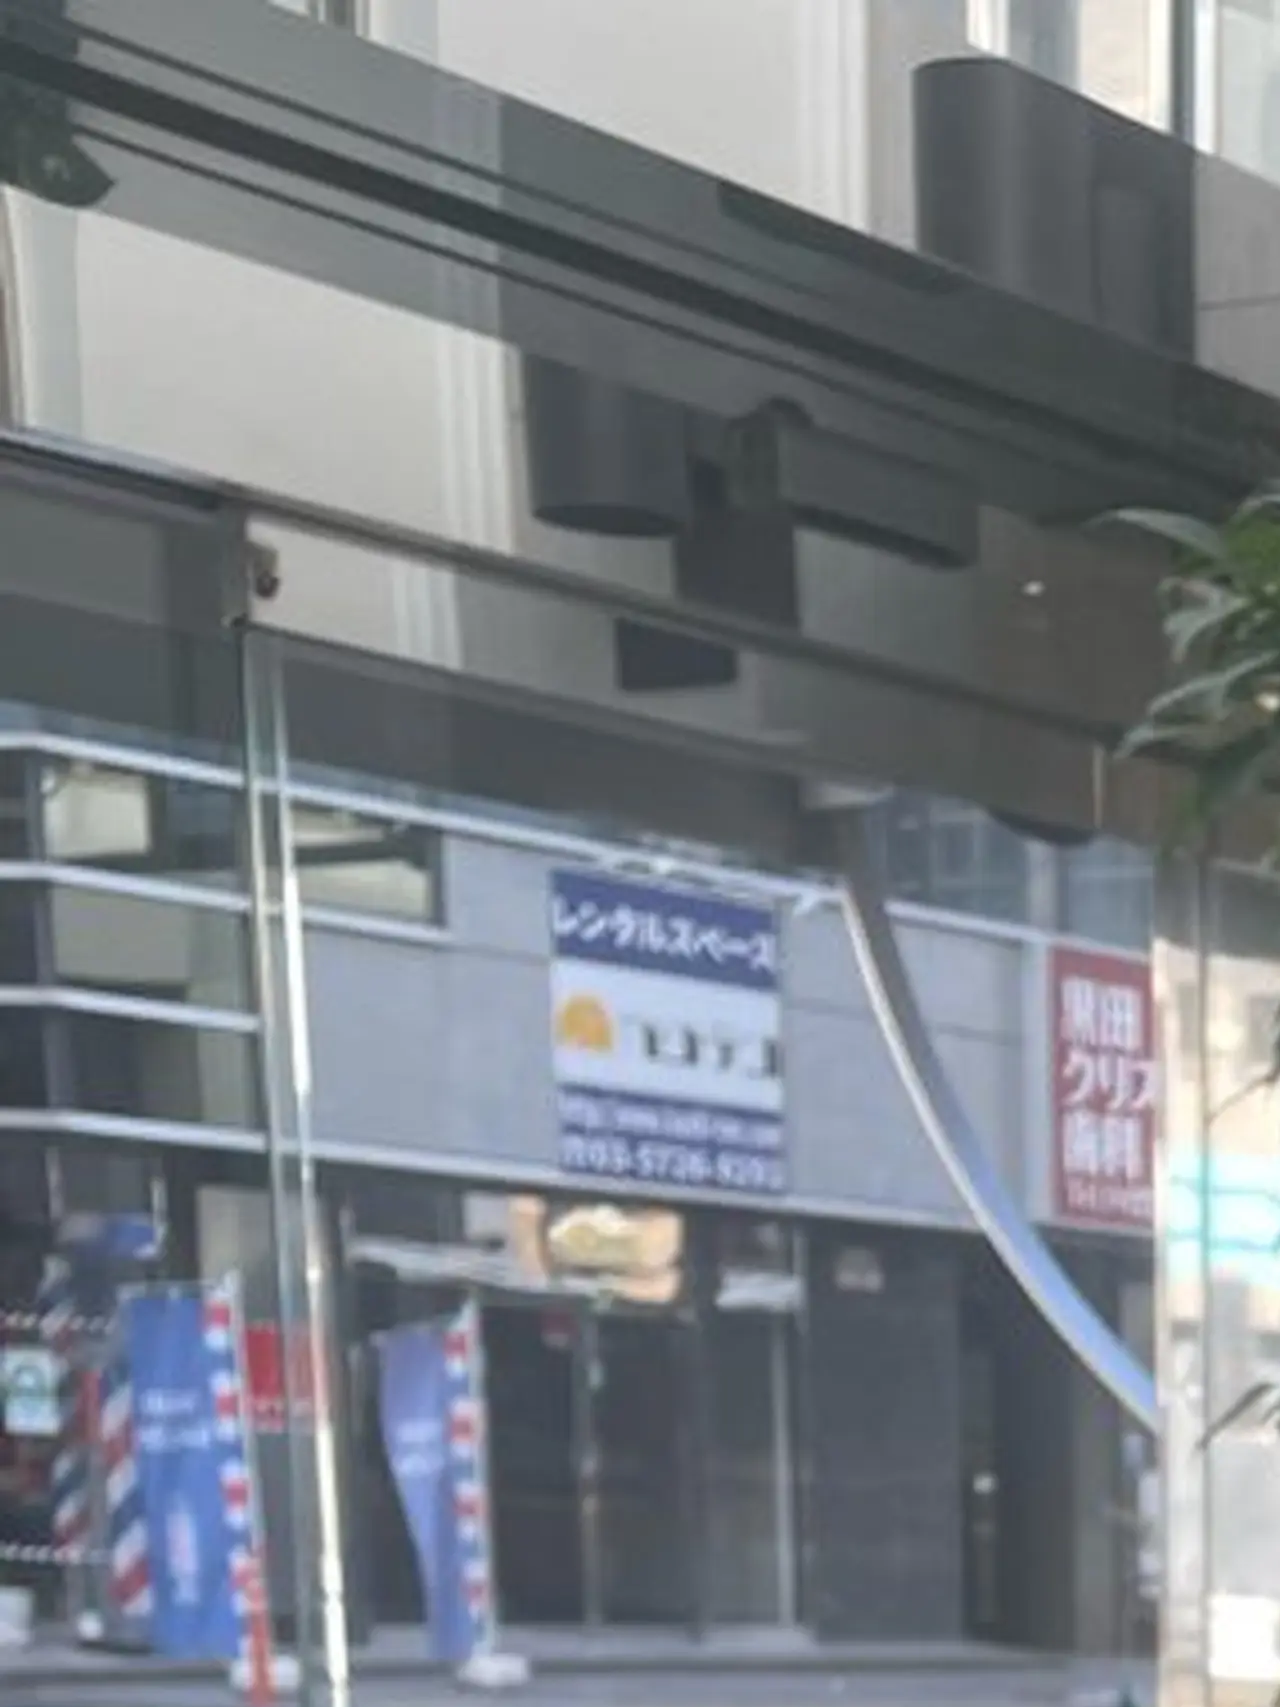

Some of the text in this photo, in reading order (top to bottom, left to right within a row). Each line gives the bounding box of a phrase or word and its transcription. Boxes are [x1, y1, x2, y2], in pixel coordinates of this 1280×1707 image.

[553, 894, 776, 973] レンタルスペース
